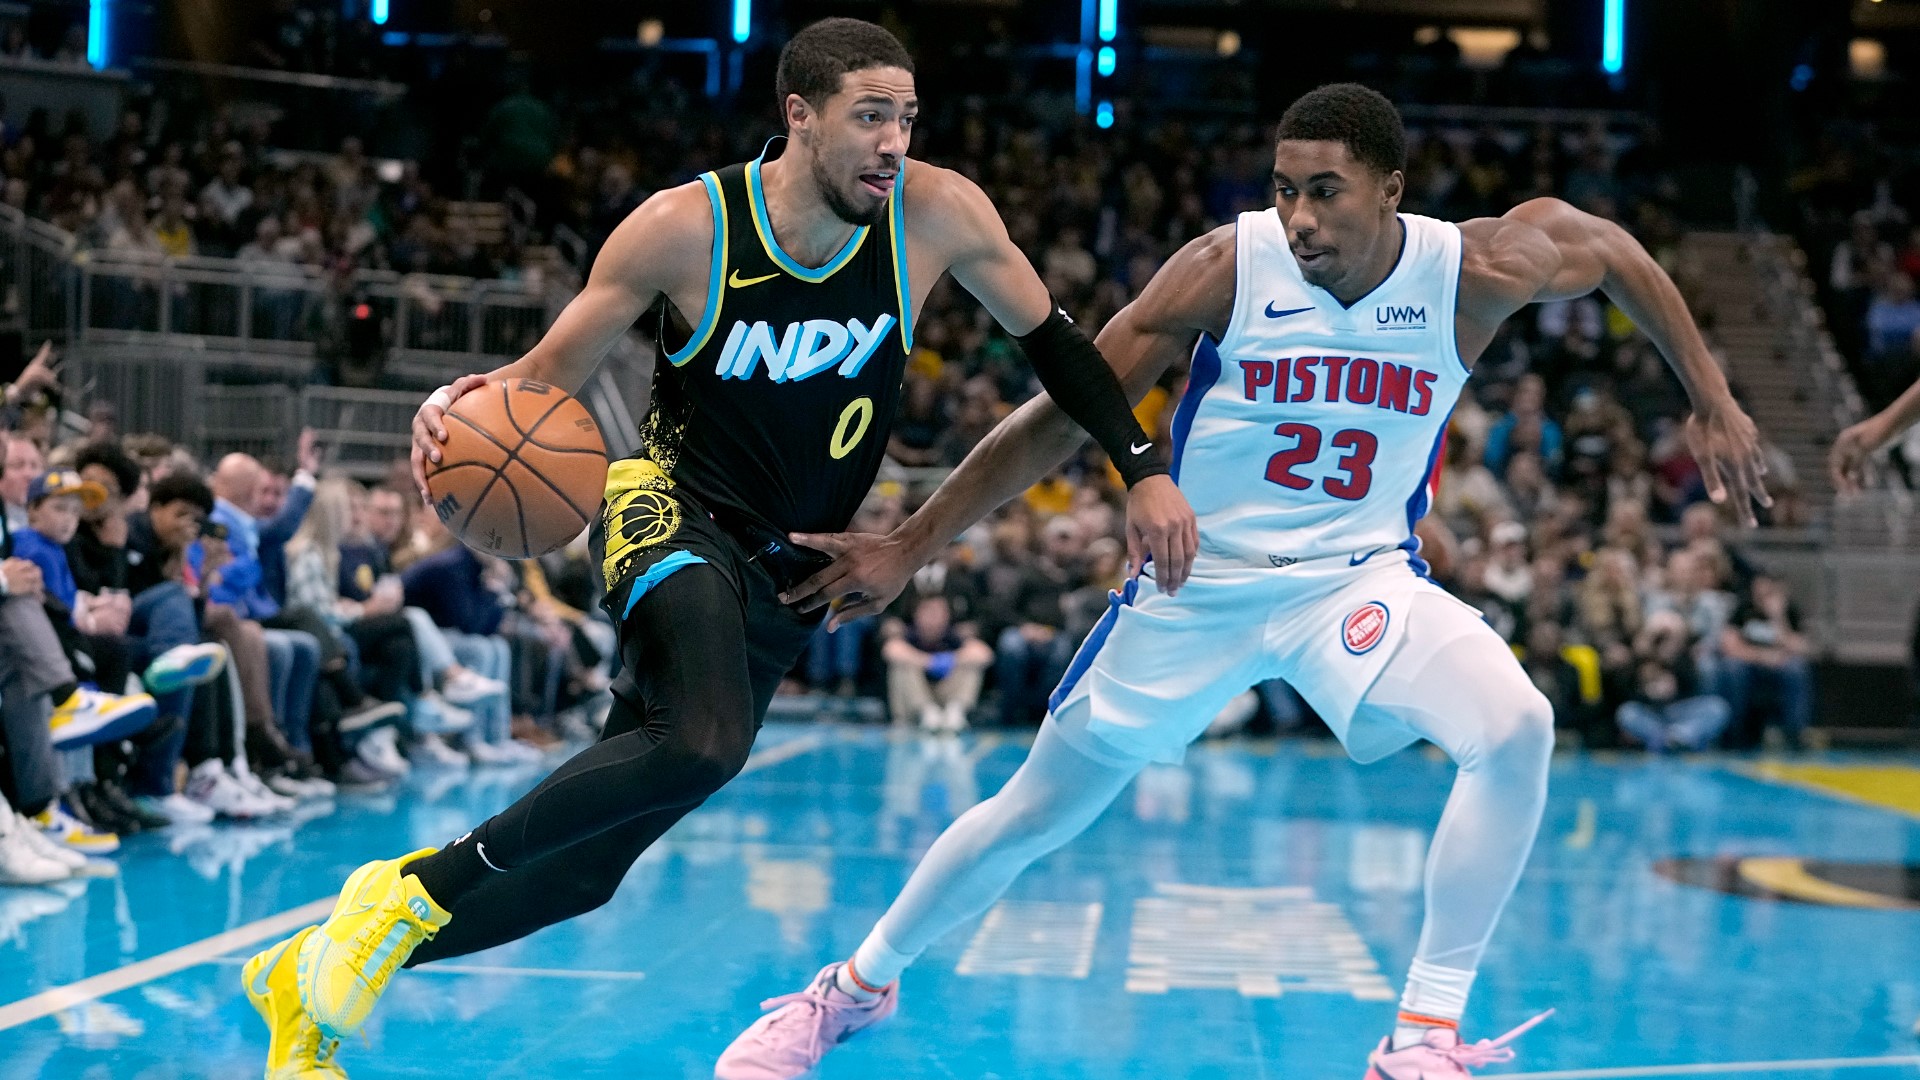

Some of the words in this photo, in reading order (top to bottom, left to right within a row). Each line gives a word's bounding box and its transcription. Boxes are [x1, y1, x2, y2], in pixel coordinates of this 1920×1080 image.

[1376, 305, 1426, 324] UWM
[715, 312, 897, 384] INDY
[1239, 356, 1438, 416] PISTONS
[829, 396, 873, 459] 0
[1264, 422, 1378, 501] 23
